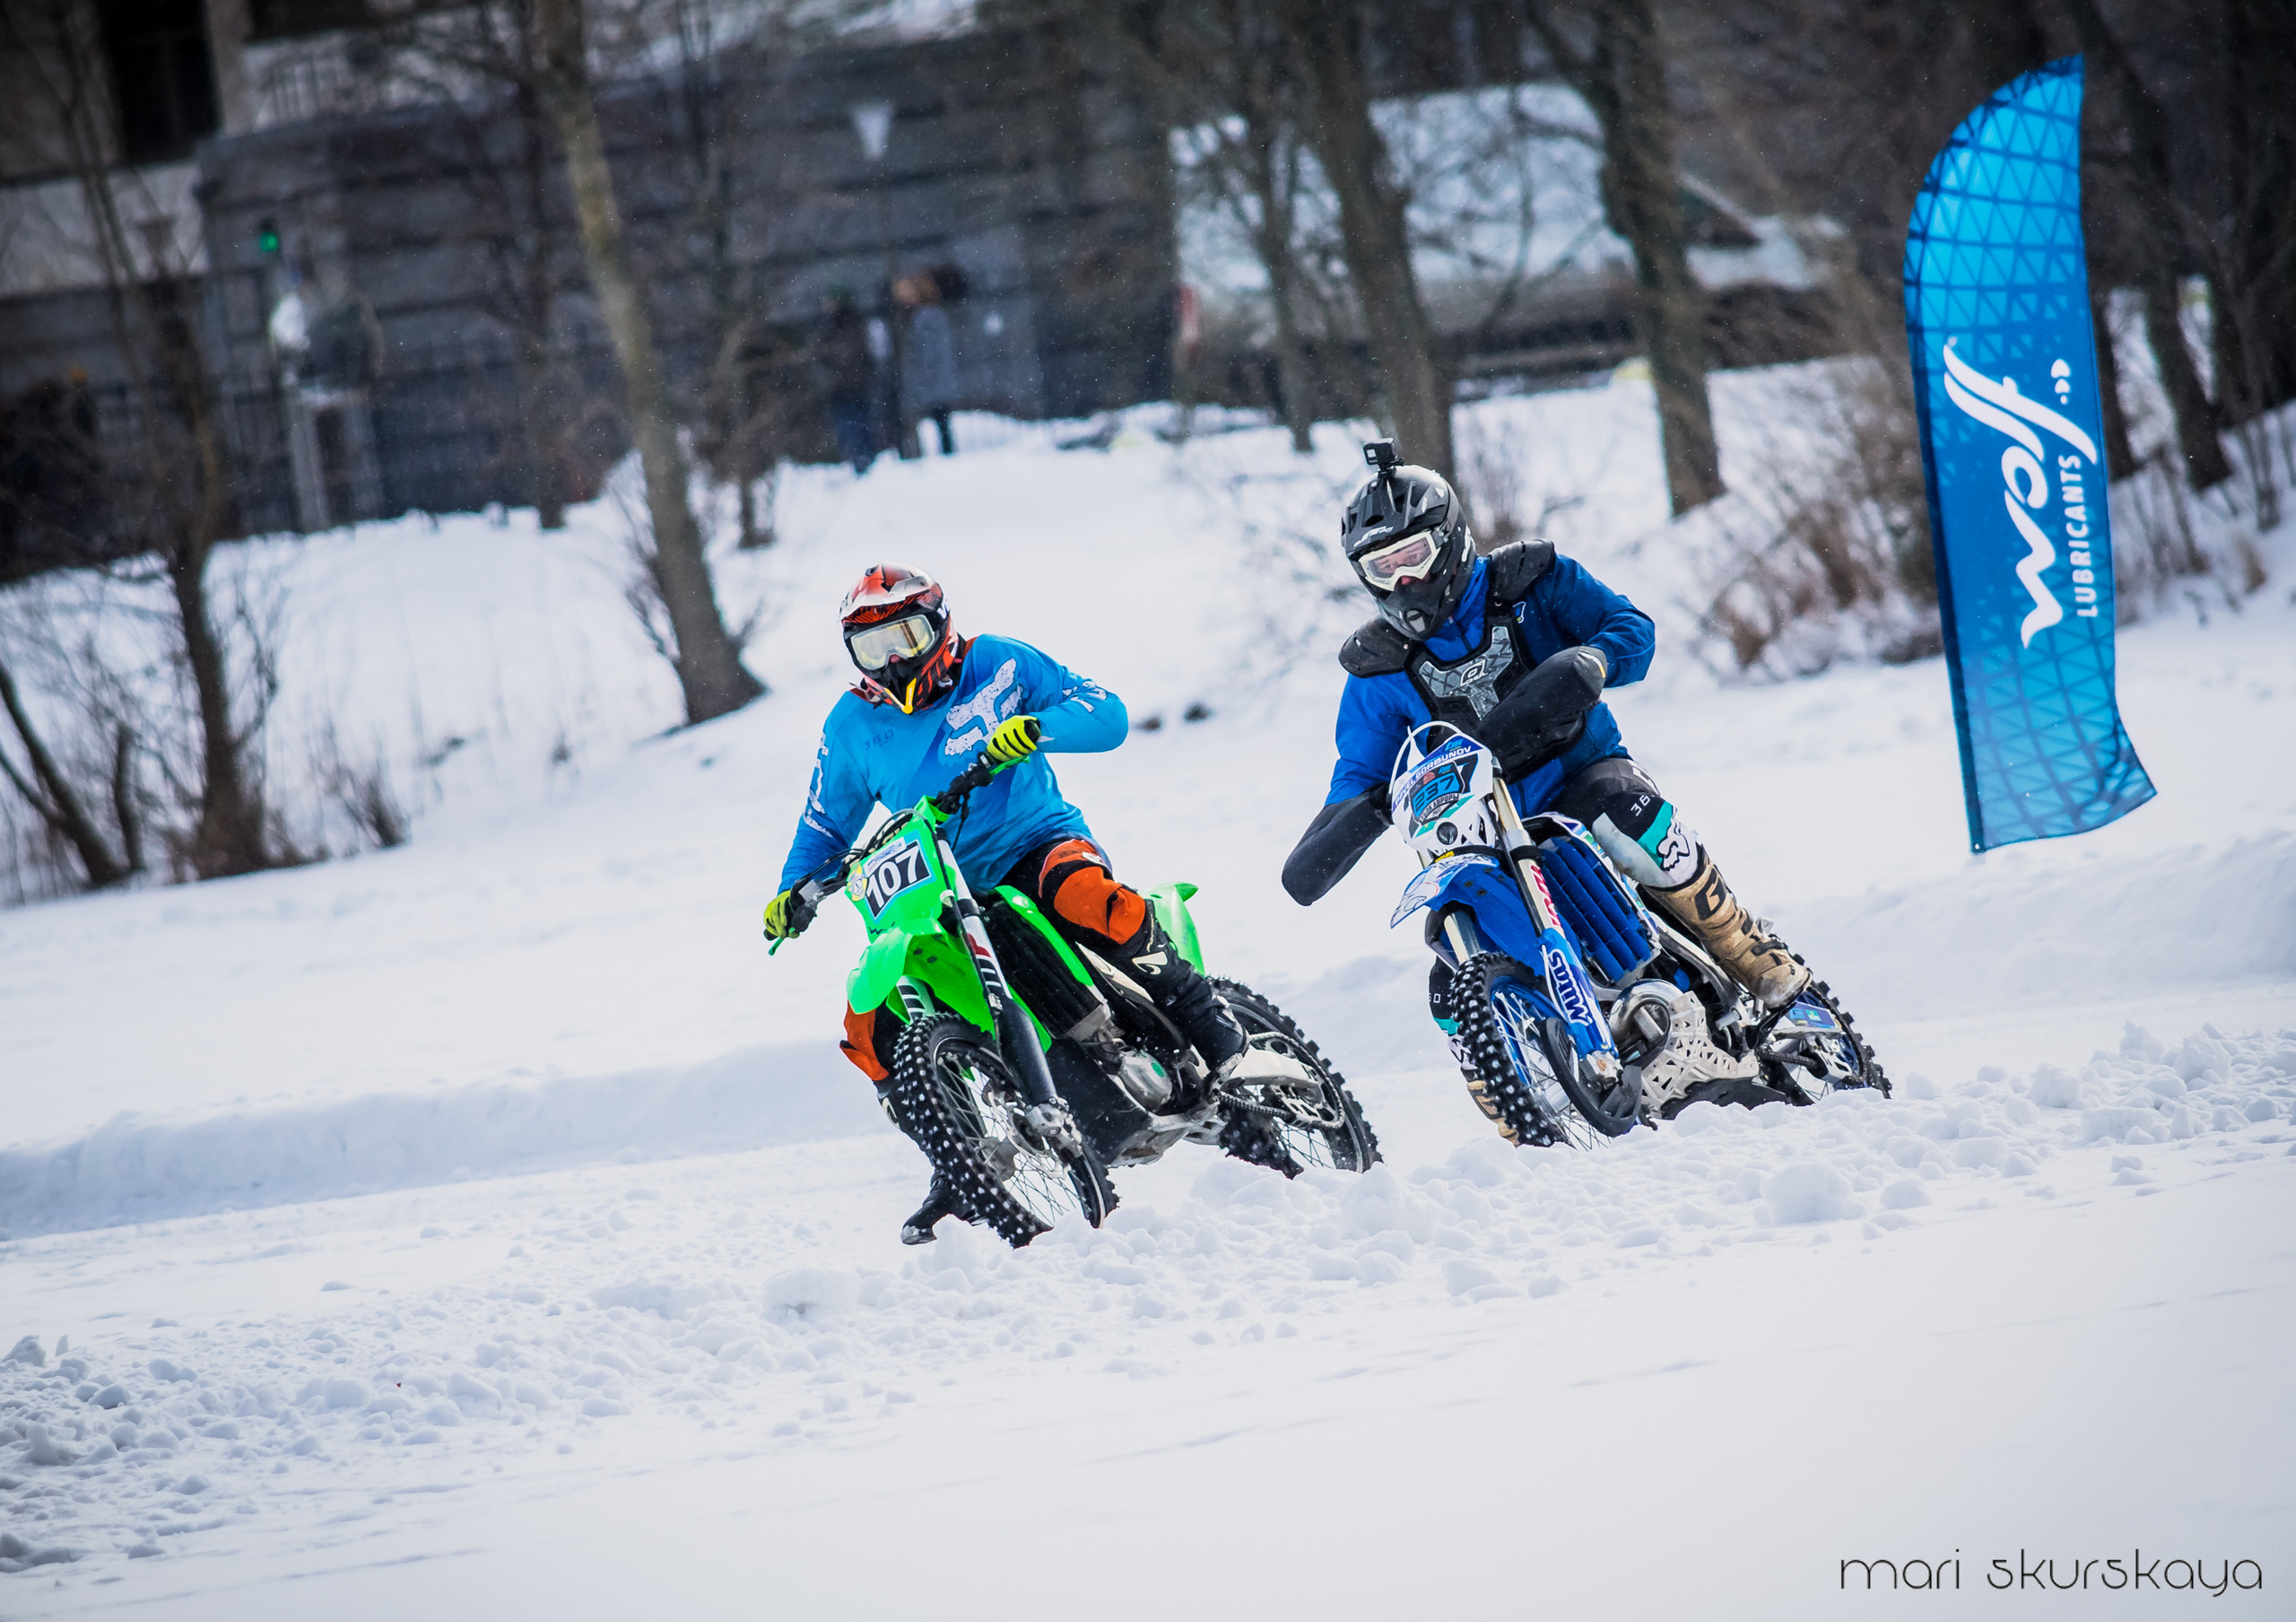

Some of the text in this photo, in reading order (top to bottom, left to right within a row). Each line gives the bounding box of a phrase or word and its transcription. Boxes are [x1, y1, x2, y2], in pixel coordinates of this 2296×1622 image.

[2057, 454, 2099, 617] LUBRICANTS
[862, 728, 893, 752] 360
[1394, 777, 1417, 807] PAVEL
[1415, 746, 1472, 780] GORBUNOV
[1413, 775, 1455, 813] 237
[1432, 792, 1460, 807] АВРОРЫ
[1630, 794, 1655, 816] 36
[866, 844, 920, 909] 107
